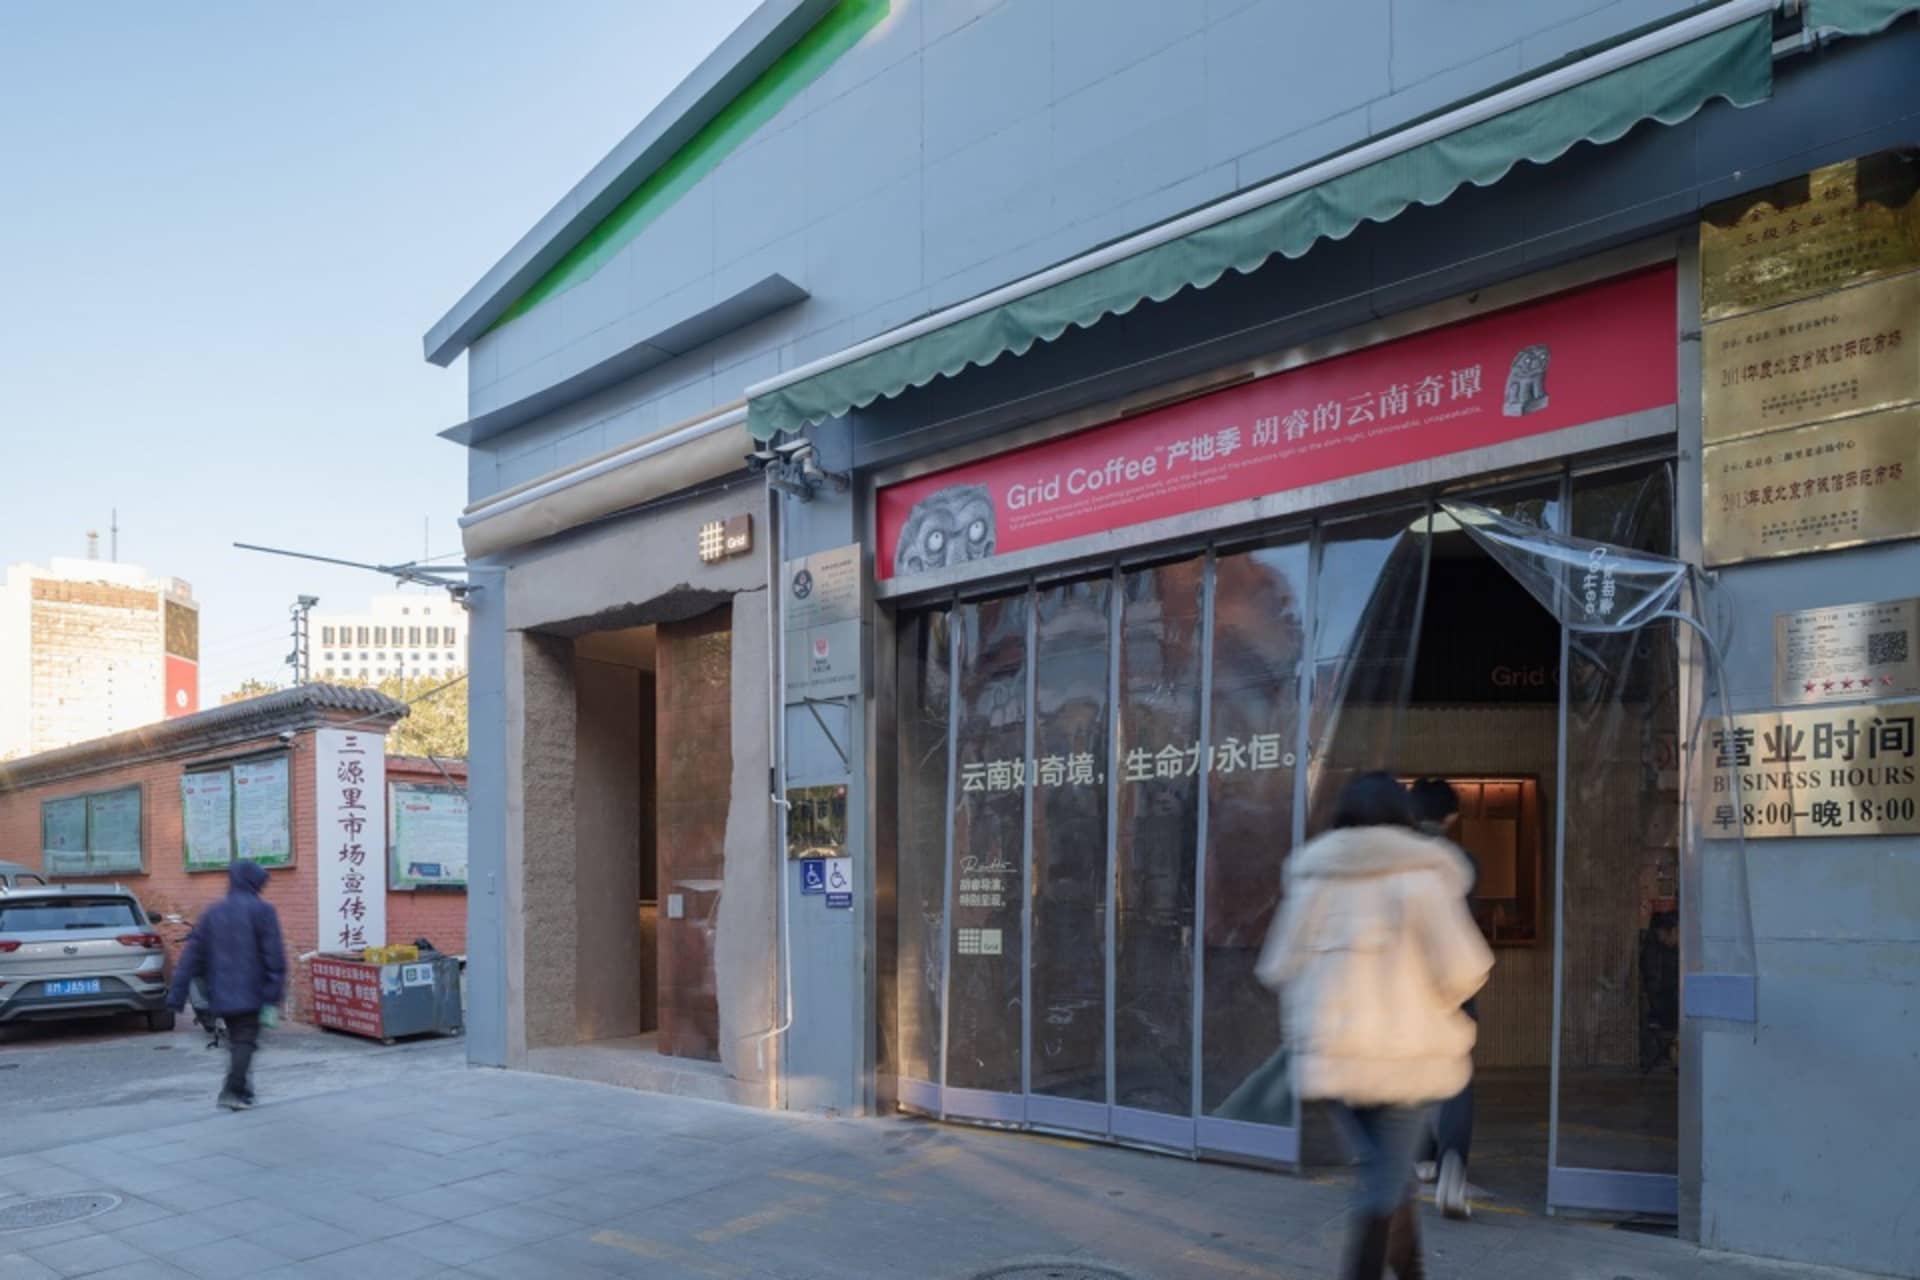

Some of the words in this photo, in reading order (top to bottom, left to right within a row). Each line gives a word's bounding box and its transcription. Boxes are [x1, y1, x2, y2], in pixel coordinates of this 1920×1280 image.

[1007, 474, 1060, 510] Grid
[1067, 455, 1157, 494] Coffee
[1166, 426, 1241, 470] 产地季
[1252, 363, 1482, 448] 胡睿的云南奇谭
[1491, 665, 1545, 688] Grid
[1711, 716, 1915, 768] 营业时间
[1830, 765, 1916, 787] HOURS
[337, 735, 368, 952] 三源里市场宣传栏
